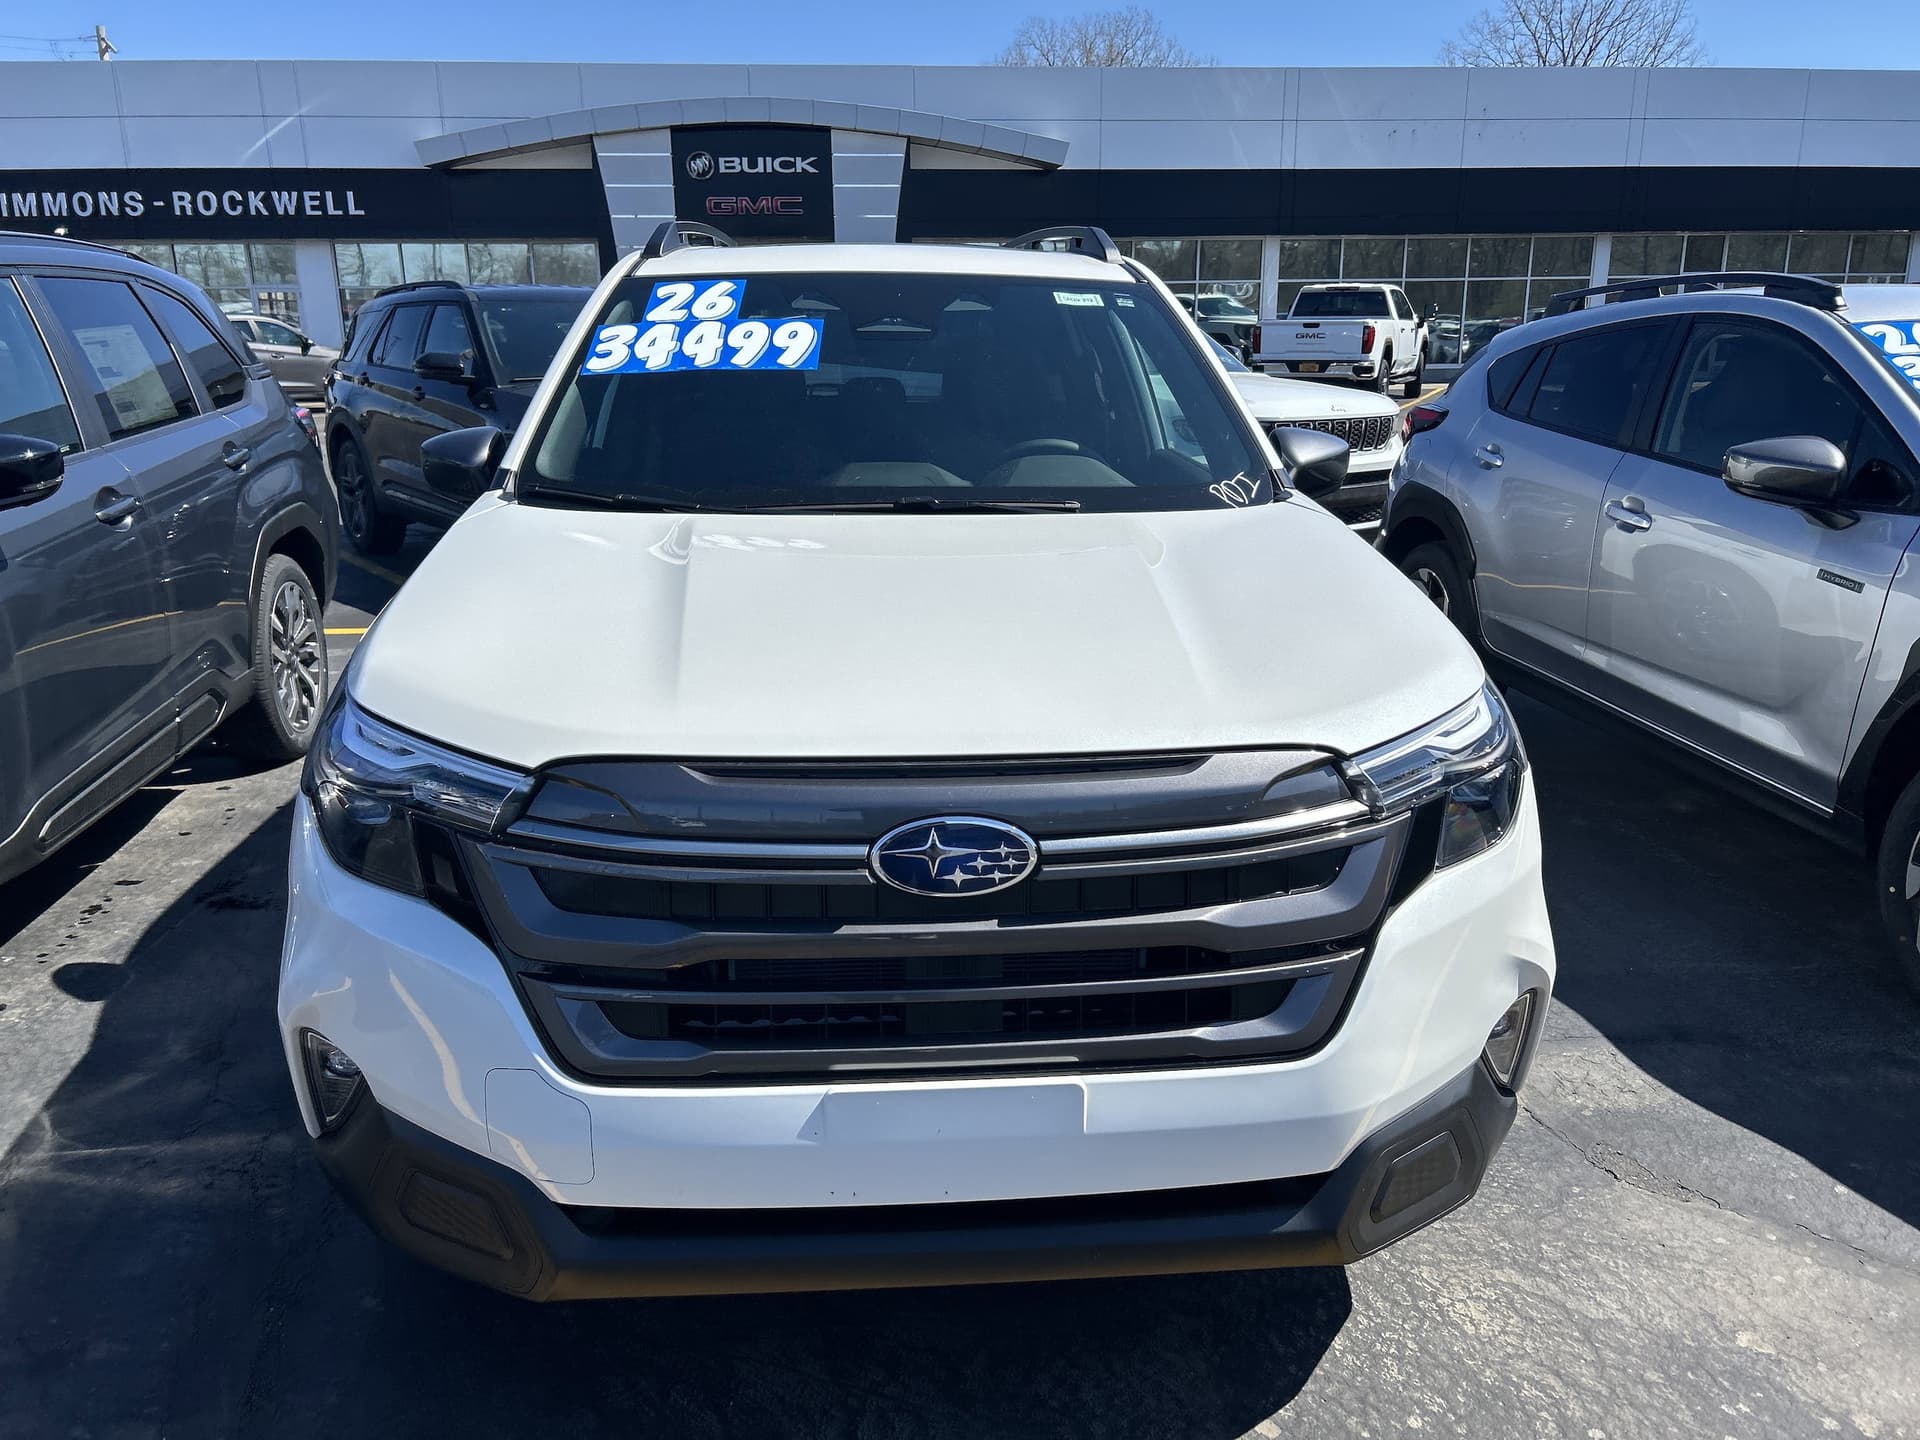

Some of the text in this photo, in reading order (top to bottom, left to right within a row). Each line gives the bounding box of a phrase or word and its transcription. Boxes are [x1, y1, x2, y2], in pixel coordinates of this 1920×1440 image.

[718, 157, 820, 173] BUICK
[706, 196, 804, 215] GMC
[646, 281, 737, 322] 26
[586, 320, 818, 372] 34499
[1822, 572, 1856, 589] HYBRID
